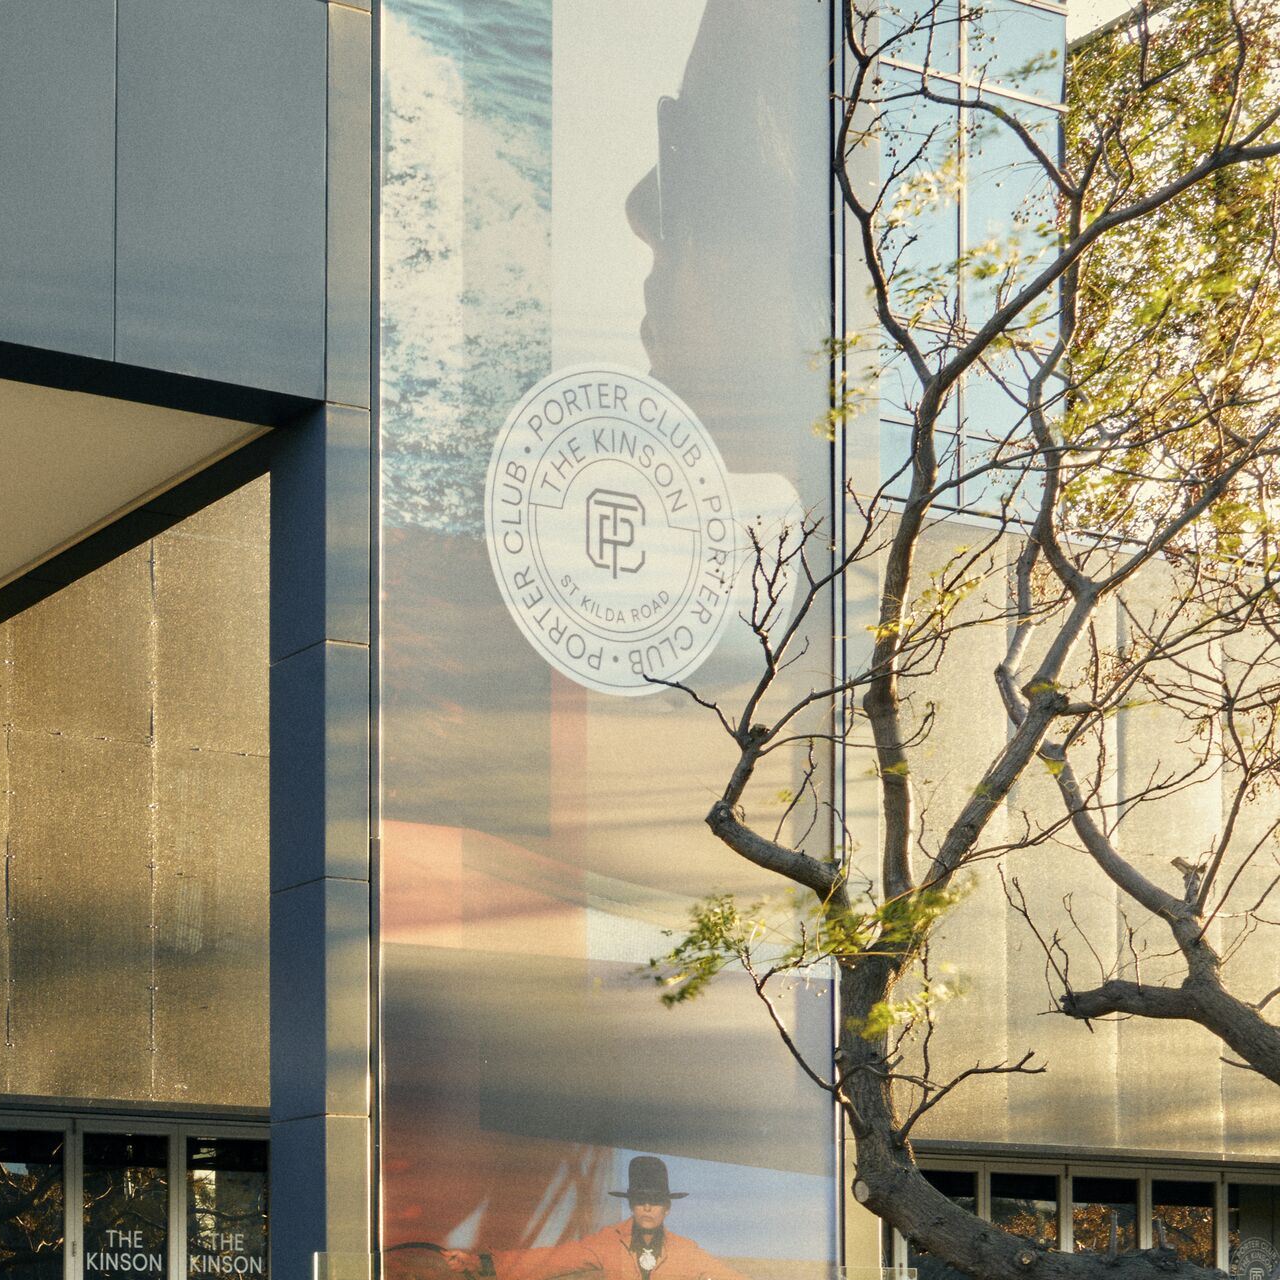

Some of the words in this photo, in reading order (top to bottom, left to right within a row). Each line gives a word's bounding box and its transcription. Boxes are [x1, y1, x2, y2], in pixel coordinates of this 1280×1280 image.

[527, 383, 627, 442] PORTER
[639, 397, 702, 468] CLUB
[540, 437, 586, 493] THE
[592, 428, 688, 513] KINSON
[501, 460, 527, 555] CLUB
[690, 495, 726, 625] PORTER
[513, 565, 604, 671] PORTER
[560, 574, 580, 597] ST
[580, 595, 626, 624] KILDA
[630, 590, 670, 623] ROAD
[628, 625, 694, 675] CLUB
[86, 1252, 162, 1272] KINSON
[105, 1229, 144, 1249] THE
[190, 1254, 262, 1274] KINSON
[209, 1232, 245, 1251] THE
